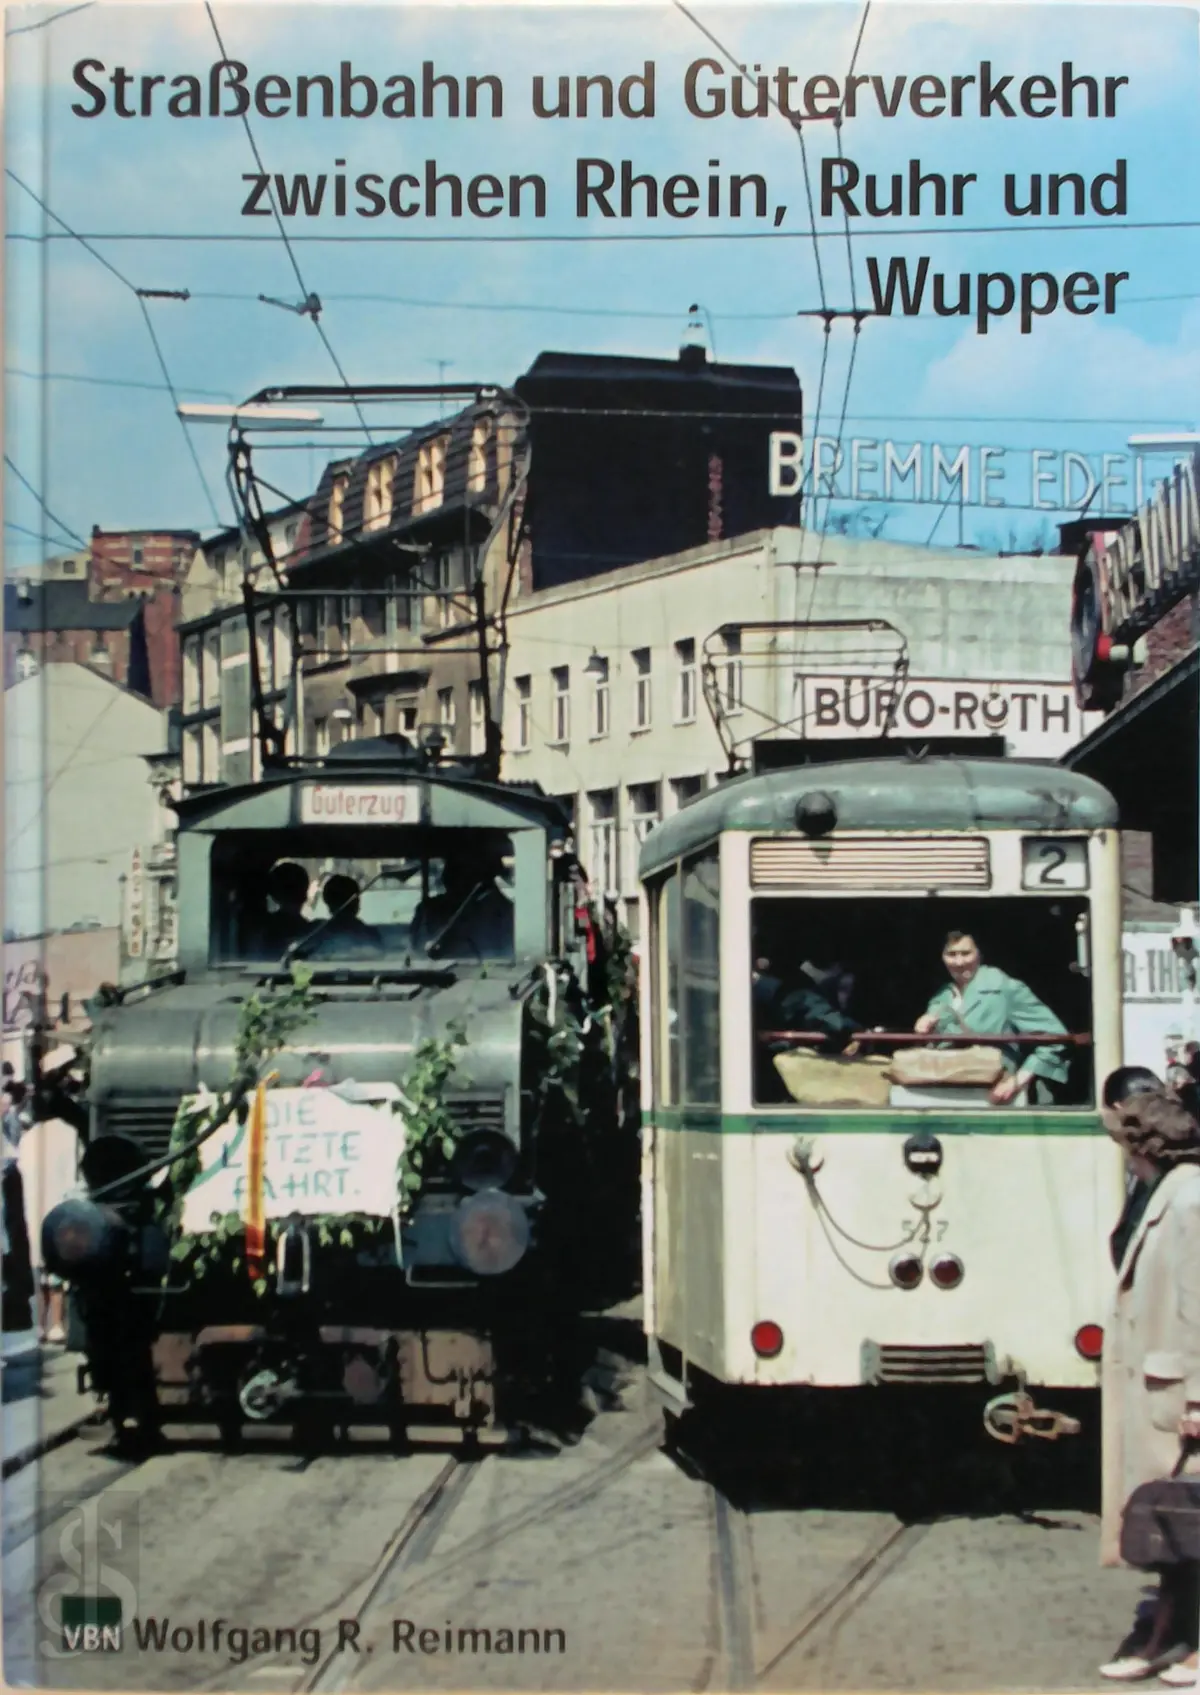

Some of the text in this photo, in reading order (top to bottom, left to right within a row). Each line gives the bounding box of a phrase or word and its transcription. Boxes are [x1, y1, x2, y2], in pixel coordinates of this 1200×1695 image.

[70, 57, 1129, 119] Straßenbahn und Güterverkehr
[241, 157, 1128, 228] zwischen Rhein, Ruhr und
[866, 255, 1130, 335] Wupper
[768, 430, 1006, 508] BREMME
[1038, 846, 1067, 885] 2
[221, 1130, 362, 1169] LTZTE
[63, 1623, 122, 1651] VBN
[133, 1618, 567, 1662] Wolfgang R. Reimann
